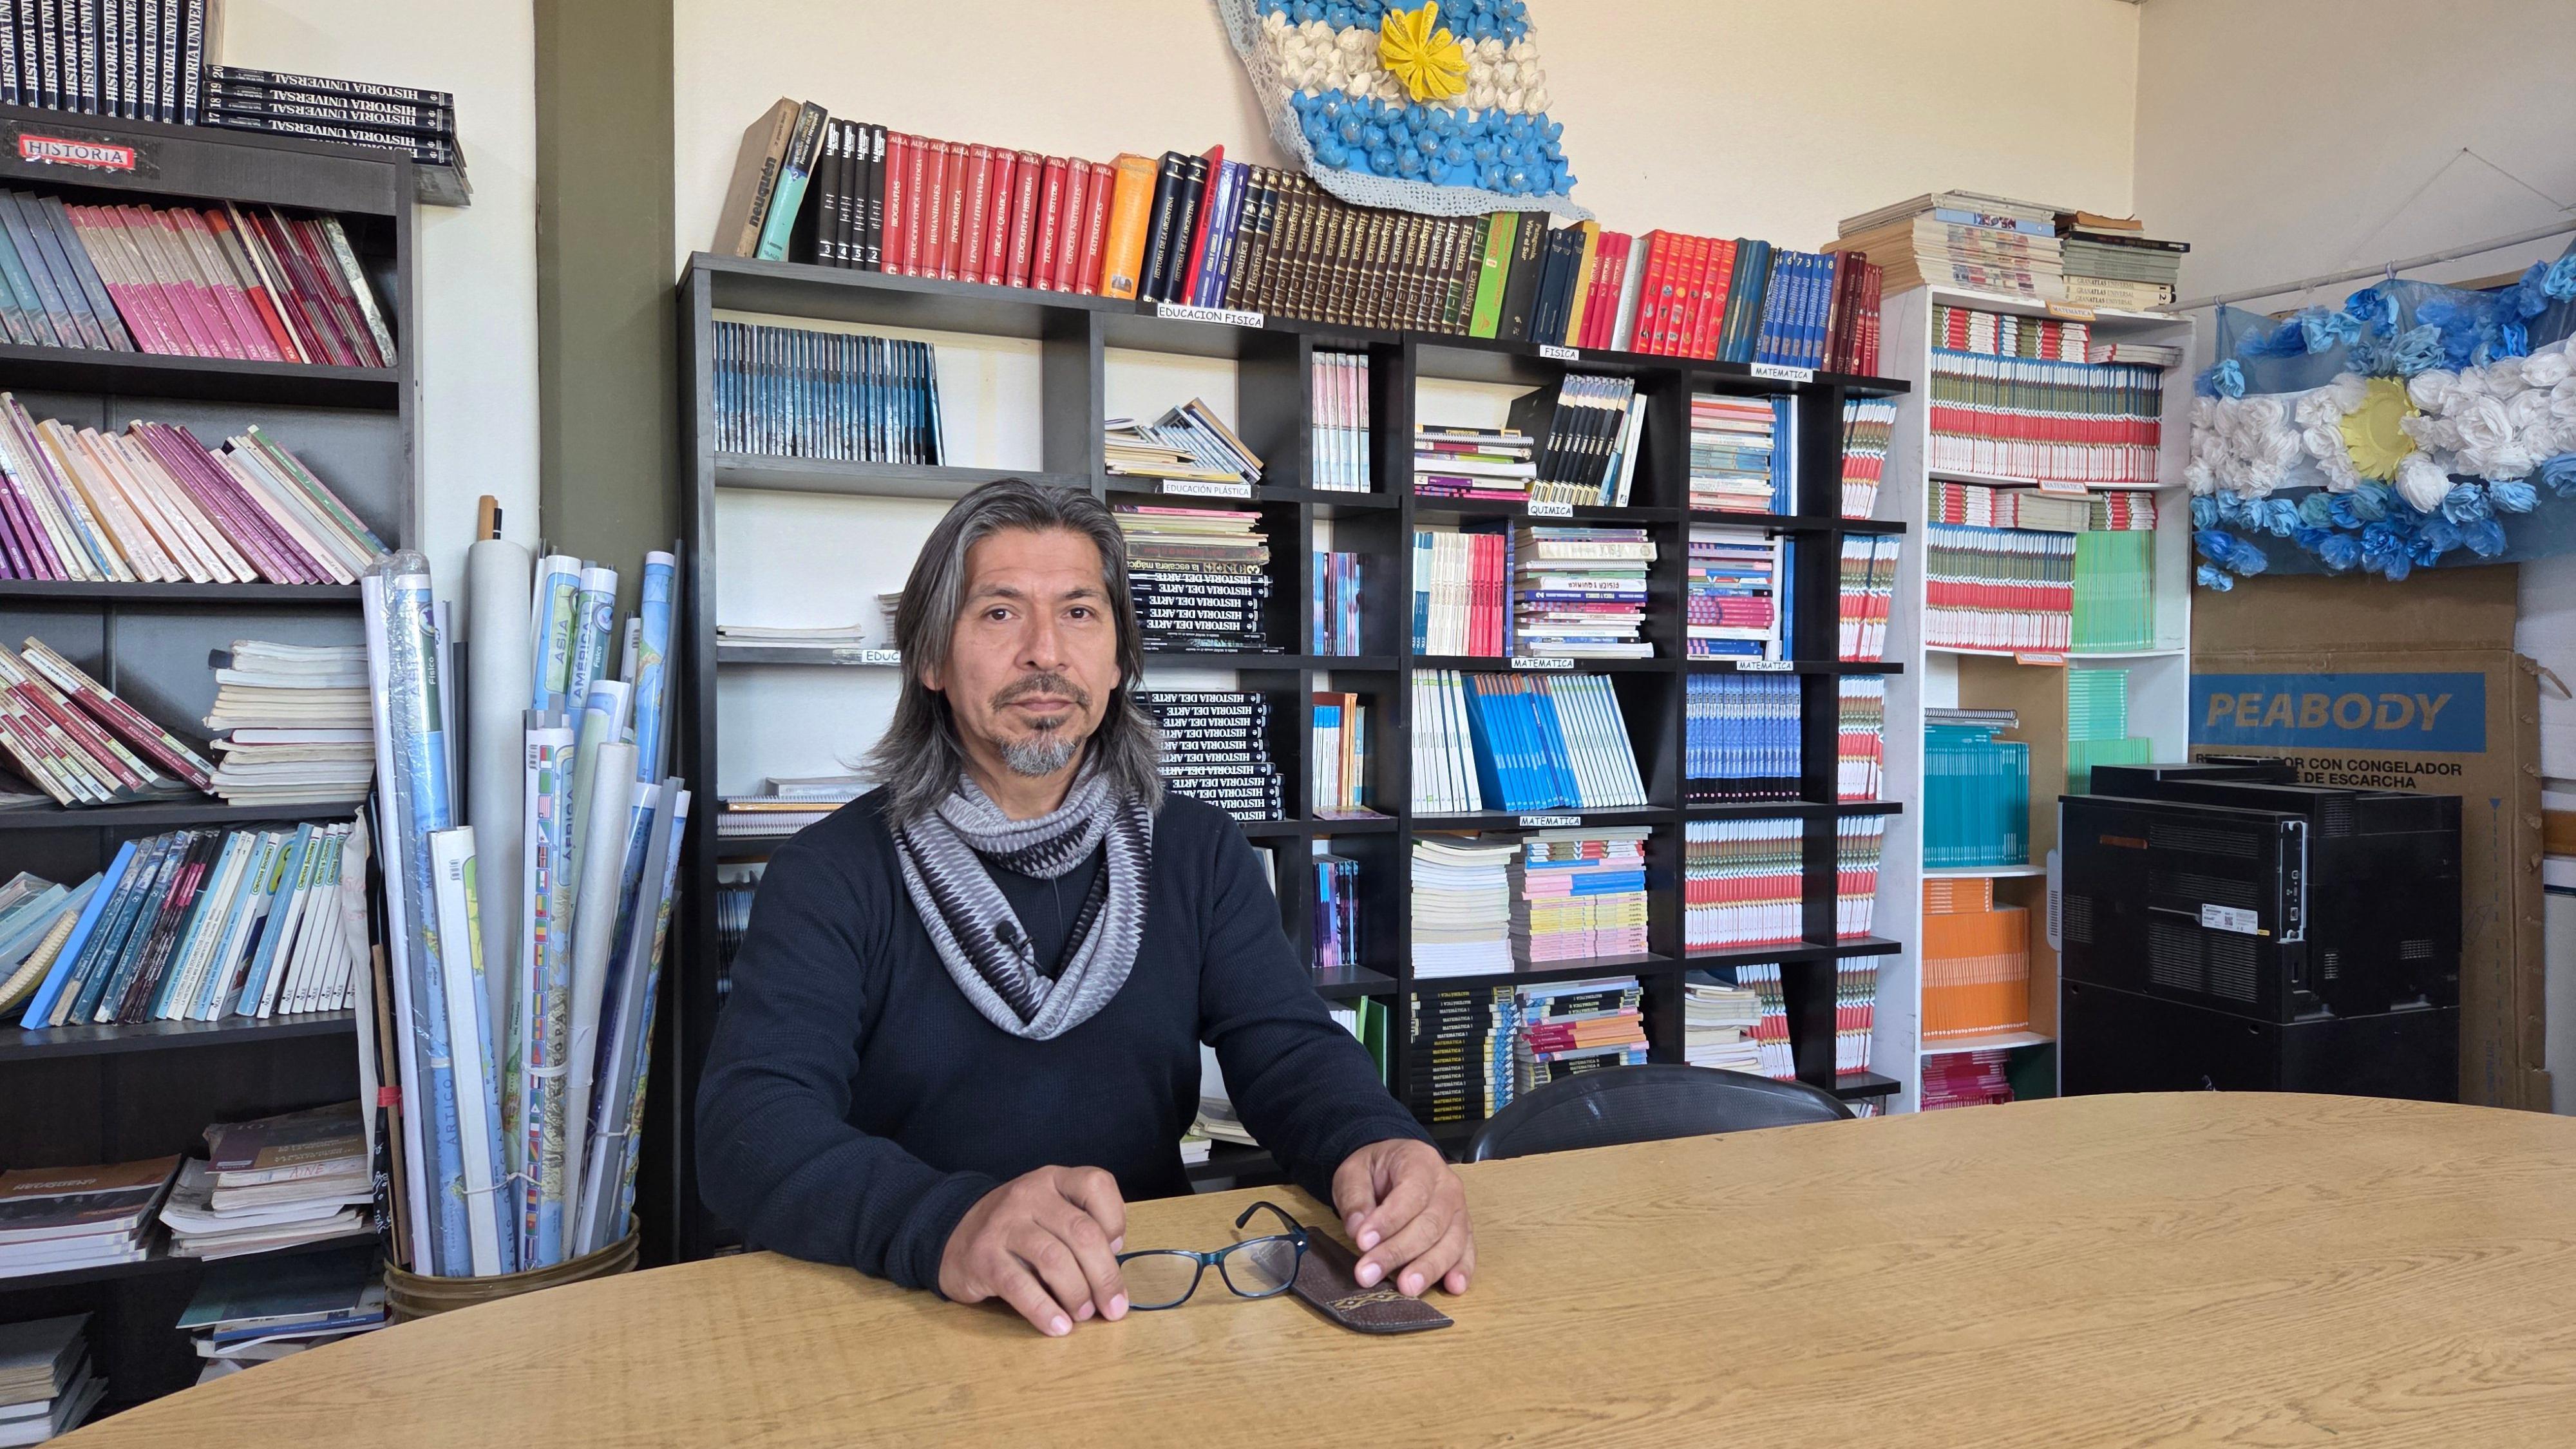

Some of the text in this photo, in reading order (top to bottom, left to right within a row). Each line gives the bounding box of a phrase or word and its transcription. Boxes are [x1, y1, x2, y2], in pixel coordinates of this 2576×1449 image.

[1, 26, 15, 88] HISTORIA
[43, 30, 57, 93] HISTORIA
[81, 37, 94, 98] HISTORIA
[124, 43, 137, 103] HISTORIA
[213, 66, 223, 79] 20
[163, 49, 175, 107] HISTORIA
[185, 44, 199, 109] HISTORIA
[272, 74, 349, 91] UNIVERSAL
[211, 83, 222, 93] 19
[353, 83, 418, 100] HISTORIA
[210, 98, 222, 109] 18
[270, 90, 347, 108] UNIVERSAL
[270, 103, 346, 119] UNIVERSAL
[351, 100, 416, 117] HISTORIA
[209, 112, 220, 124] 17
[352, 111, 415, 126] HISTORIA
[269, 120, 346, 138] UNIVERSAL
[349, 129, 415, 147] HISTORIA
[890, 136, 908, 146] AULA
[28, 141, 124, 163] HISTORIA
[932, 143, 949, 153] AULA
[974, 149, 992, 159] AULA
[998, 152, 1015, 162] AULA
[793, 171, 799, 180] 2
[1074, 161, 1090, 173] AULA
[1095, 165, 1112, 176] AULA
[750, 157, 777, 228] neuquén
[891, 180, 900, 227] BIOGRAFIAS
[998, 191, 1007, 225] QUIMICA
[930, 184, 941, 245] HUMANIDADES
[951, 189, 962, 243] INFORMATICA
[1044, 224, 1053, 263] TECNICAS
[1153, 250, 1164, 279] HISTORIA
[1163, 196, 1175, 231] ARGENTINA
[1174, 252, 1185, 281] HISTORIA
[1184, 200, 1195, 234] ARGENTINA
[970, 232, 980, 263] LENGUA
[1787, 257, 1792, 265] 6
[1159, 307, 1262, 327] EDUCACION FISICA
[1545, 348, 1576, 358] FISICA
[1756, 368, 1808, 379] MATEMATICA
[1166, 484, 1249, 496] EDUCACIÓN PLÁSTICA
[1531, 506, 1571, 516] QUIMICA
[1156, 562, 1189, 571] escalera
[1247, 564, 1259, 573] 3
[1159, 584, 1251, 595] HISTORIA DEL ARTE
[1150, 596, 1241, 607] HISTORIA DEL ARTE
[554, 620, 568, 664] ASIA
[866, 650, 901, 661] EDUC
[1514, 659, 1573, 668] MATEMATICA
[1739, 662, 1792, 670] MATEMATICA
[2207, 693, 2452, 731] PEABODY
[2309, 759, 2342, 770] CON
[2347, 761, 2461, 776] CONGELADOR
[1173, 779, 1198, 788] ARTE
[2305, 772, 2416, 788] DE ESCARCHA
[1521, 817, 1580, 826] MATEMATICA
[253, 848, 272, 893] Ciencias Sociales
[298, 842, 316, 888] Ciencias Sociales
[328, 860, 337, 883] Ciencias
[443, 1079, 457, 1145] ÁRTICO
